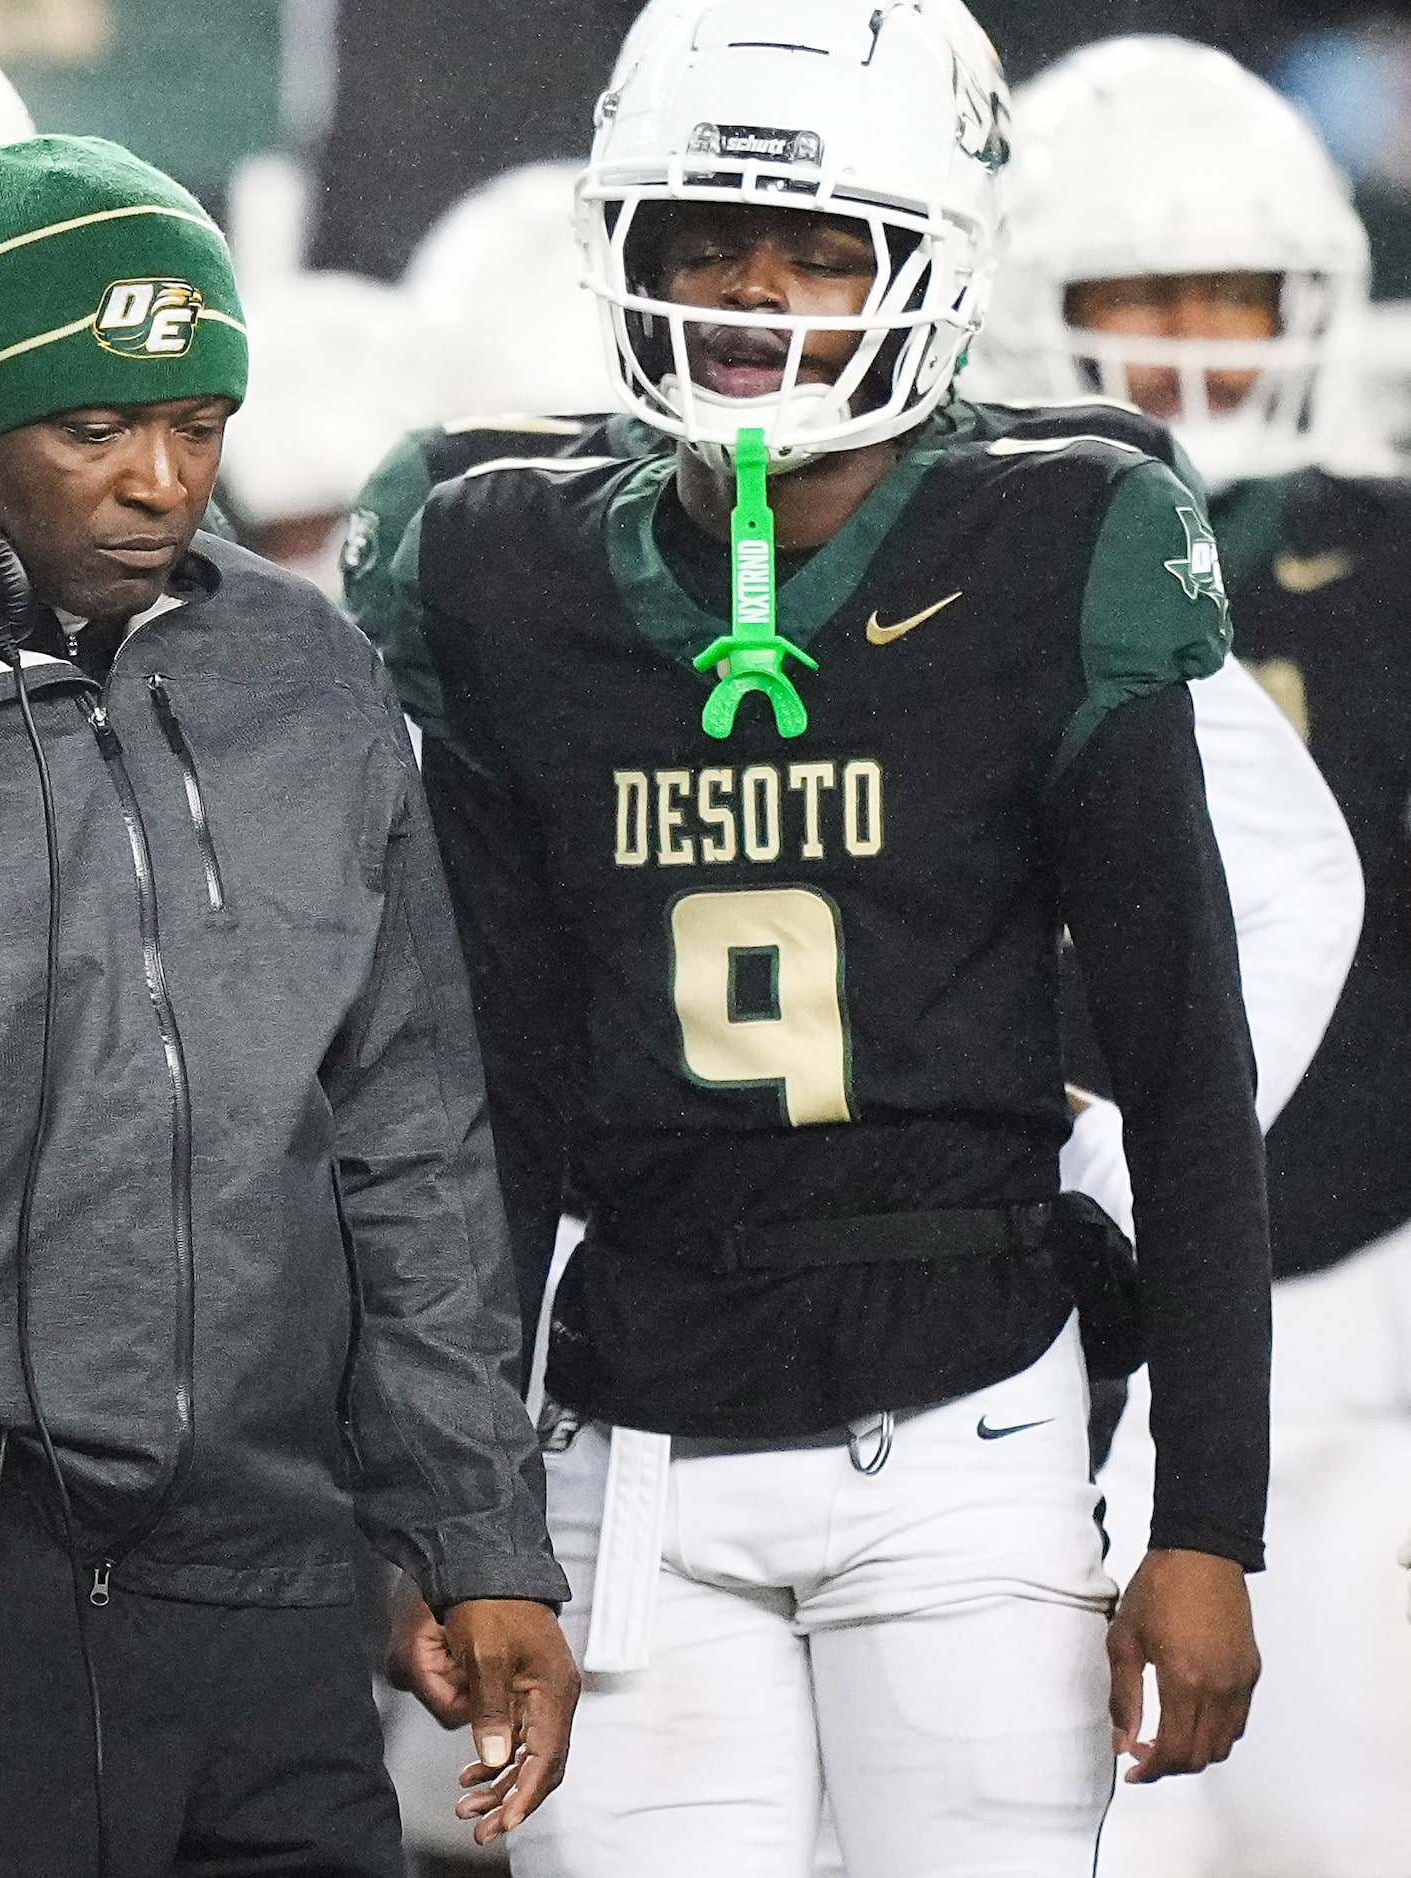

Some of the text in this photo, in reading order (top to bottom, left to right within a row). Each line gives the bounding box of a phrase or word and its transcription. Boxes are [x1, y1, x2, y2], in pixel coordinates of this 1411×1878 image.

[99, 283, 195, 353] DE
[736, 539, 770, 624] NXTRND
[614, 760, 884, 867] DESOTO
[666, 883, 853, 1127] 9
